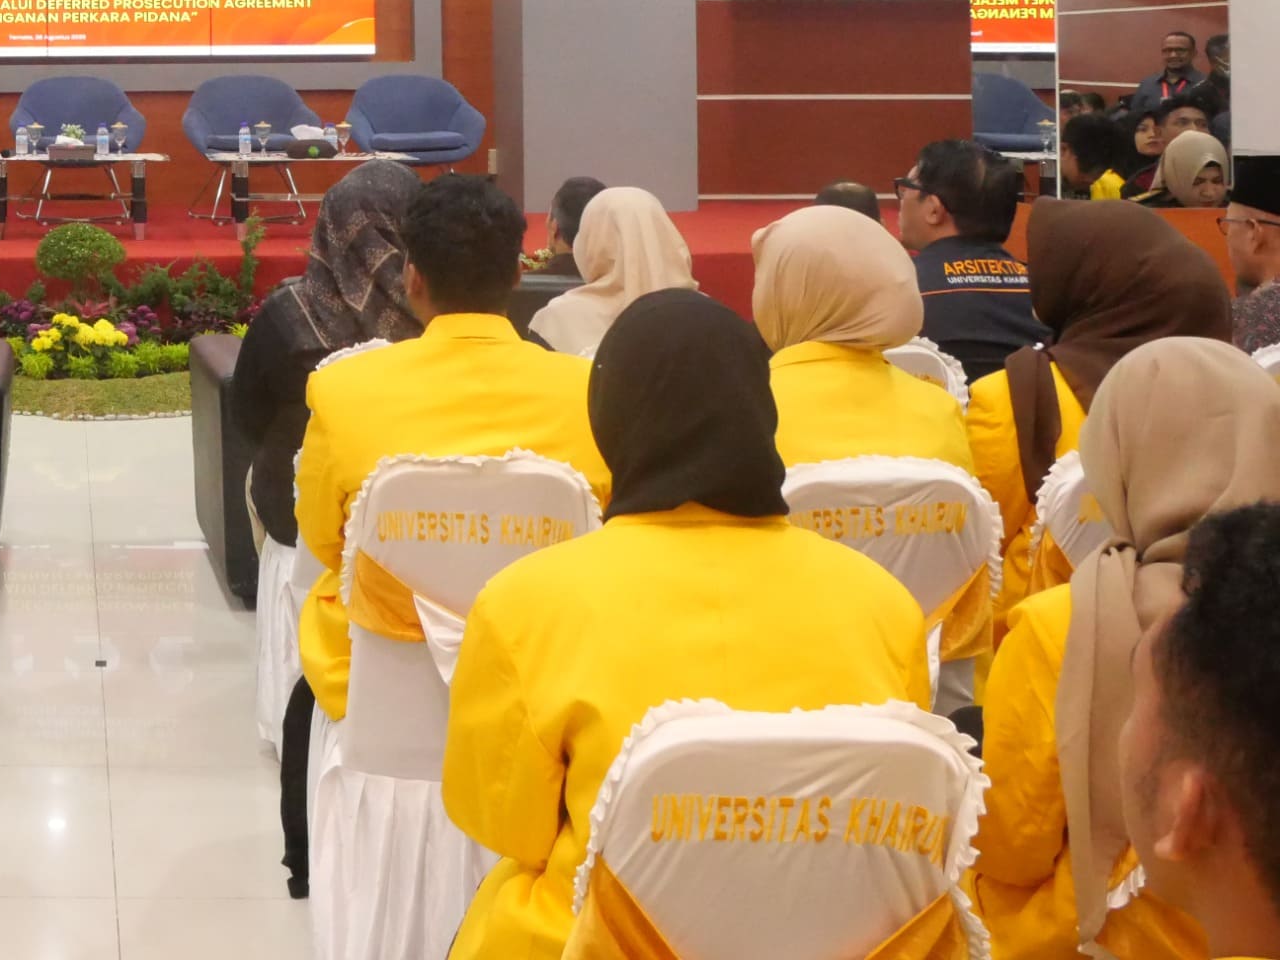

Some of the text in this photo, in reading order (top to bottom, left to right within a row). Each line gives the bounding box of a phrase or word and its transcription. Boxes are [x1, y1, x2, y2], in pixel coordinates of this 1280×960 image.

[62, 11, 130, 22] PERKARA
[377, 511, 490, 544] UNIVERSITAS
[651, 794, 833, 843] UNIVERSITAS
